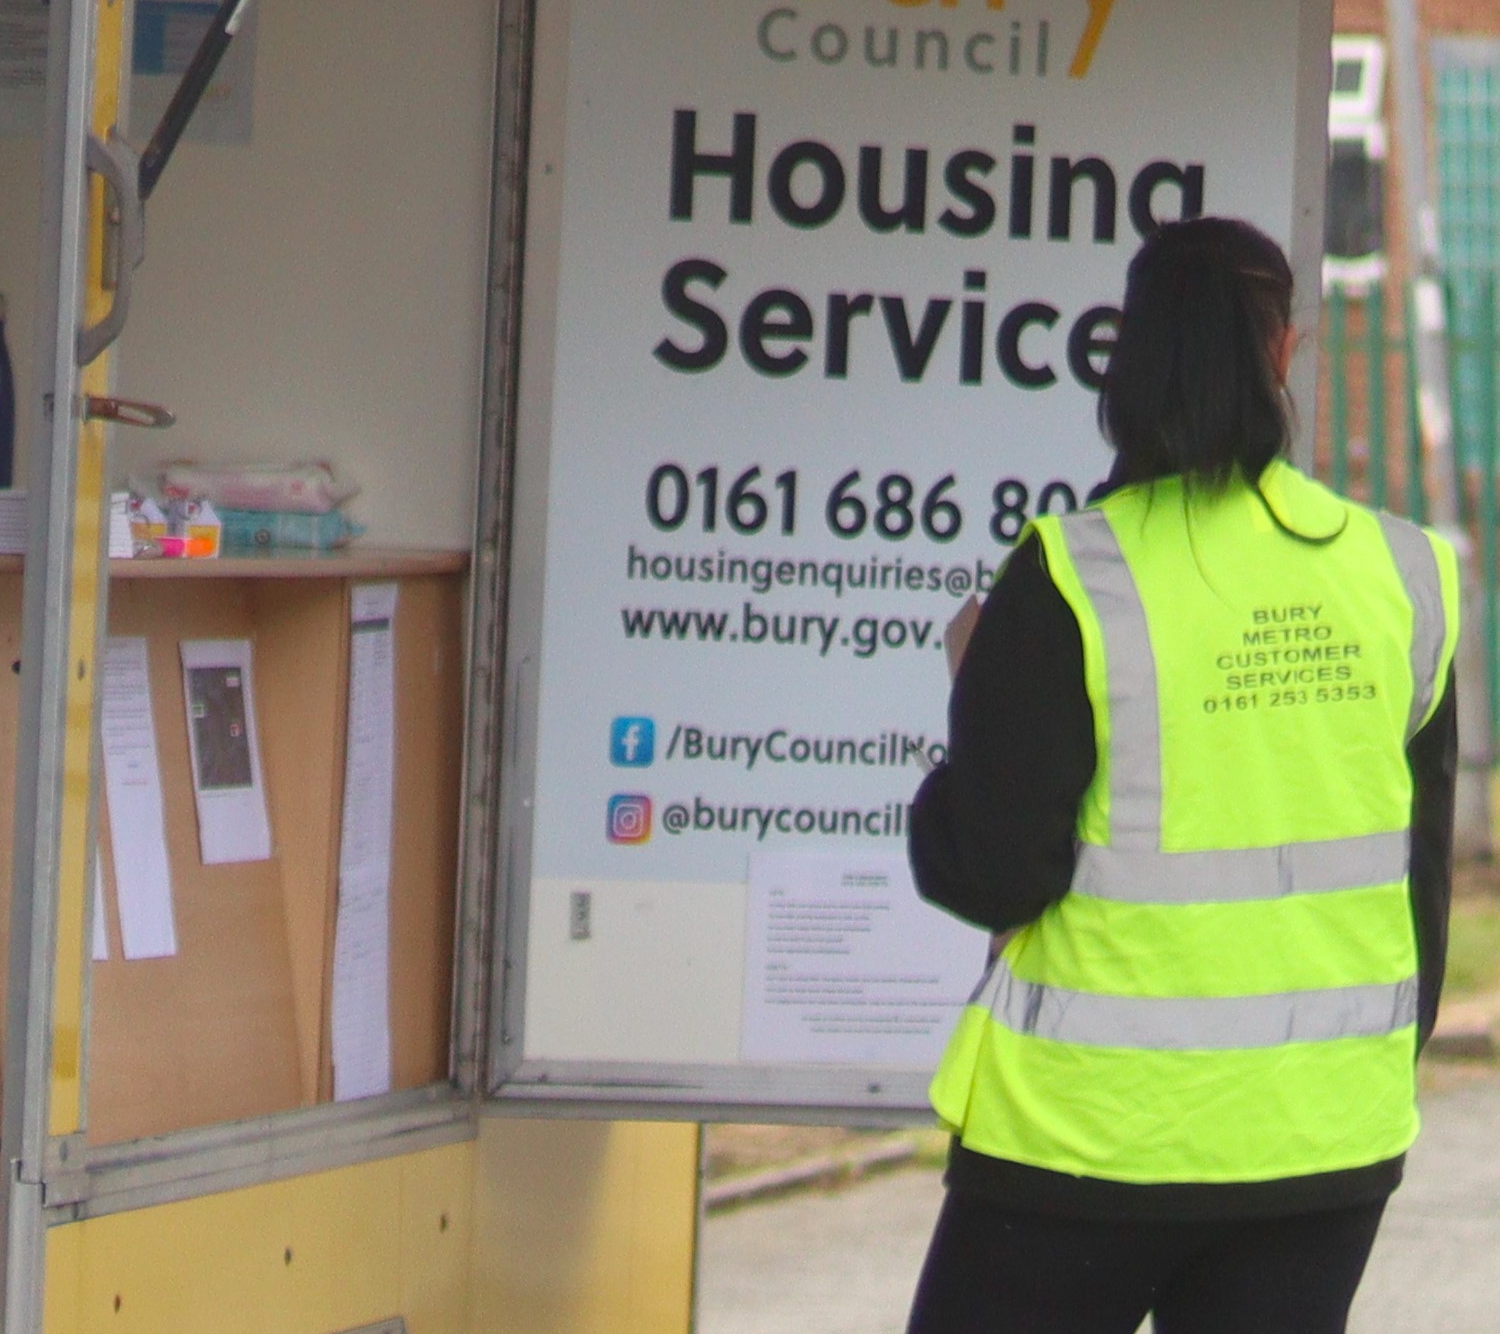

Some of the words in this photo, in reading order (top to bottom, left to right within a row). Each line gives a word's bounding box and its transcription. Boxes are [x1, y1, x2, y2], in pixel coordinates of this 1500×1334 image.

[757, 7, 1049, 78] Council
[653, 259, 1123, 393] Service
[645, 463, 797, 535] 0161
[825, 469, 963, 543] 686
[626, 544, 996, 598] housingenquiries@b
[621, 602, 943, 657] www.bury.gov.
[1243, 625, 1333, 647] METRO
[1252, 604, 1323, 624] BURY
[1215, 644, 1362, 671] CUSTOMER
[1226, 665, 1353, 691] SERVICES
[1203, 693, 1258, 715] 0161
[1269, 690, 1308, 708] 253
[1316, 684, 1377, 704] 5353
[665, 725, 949, 771] /BuryCouncilHo
[662, 797, 912, 842] @burycouncil
